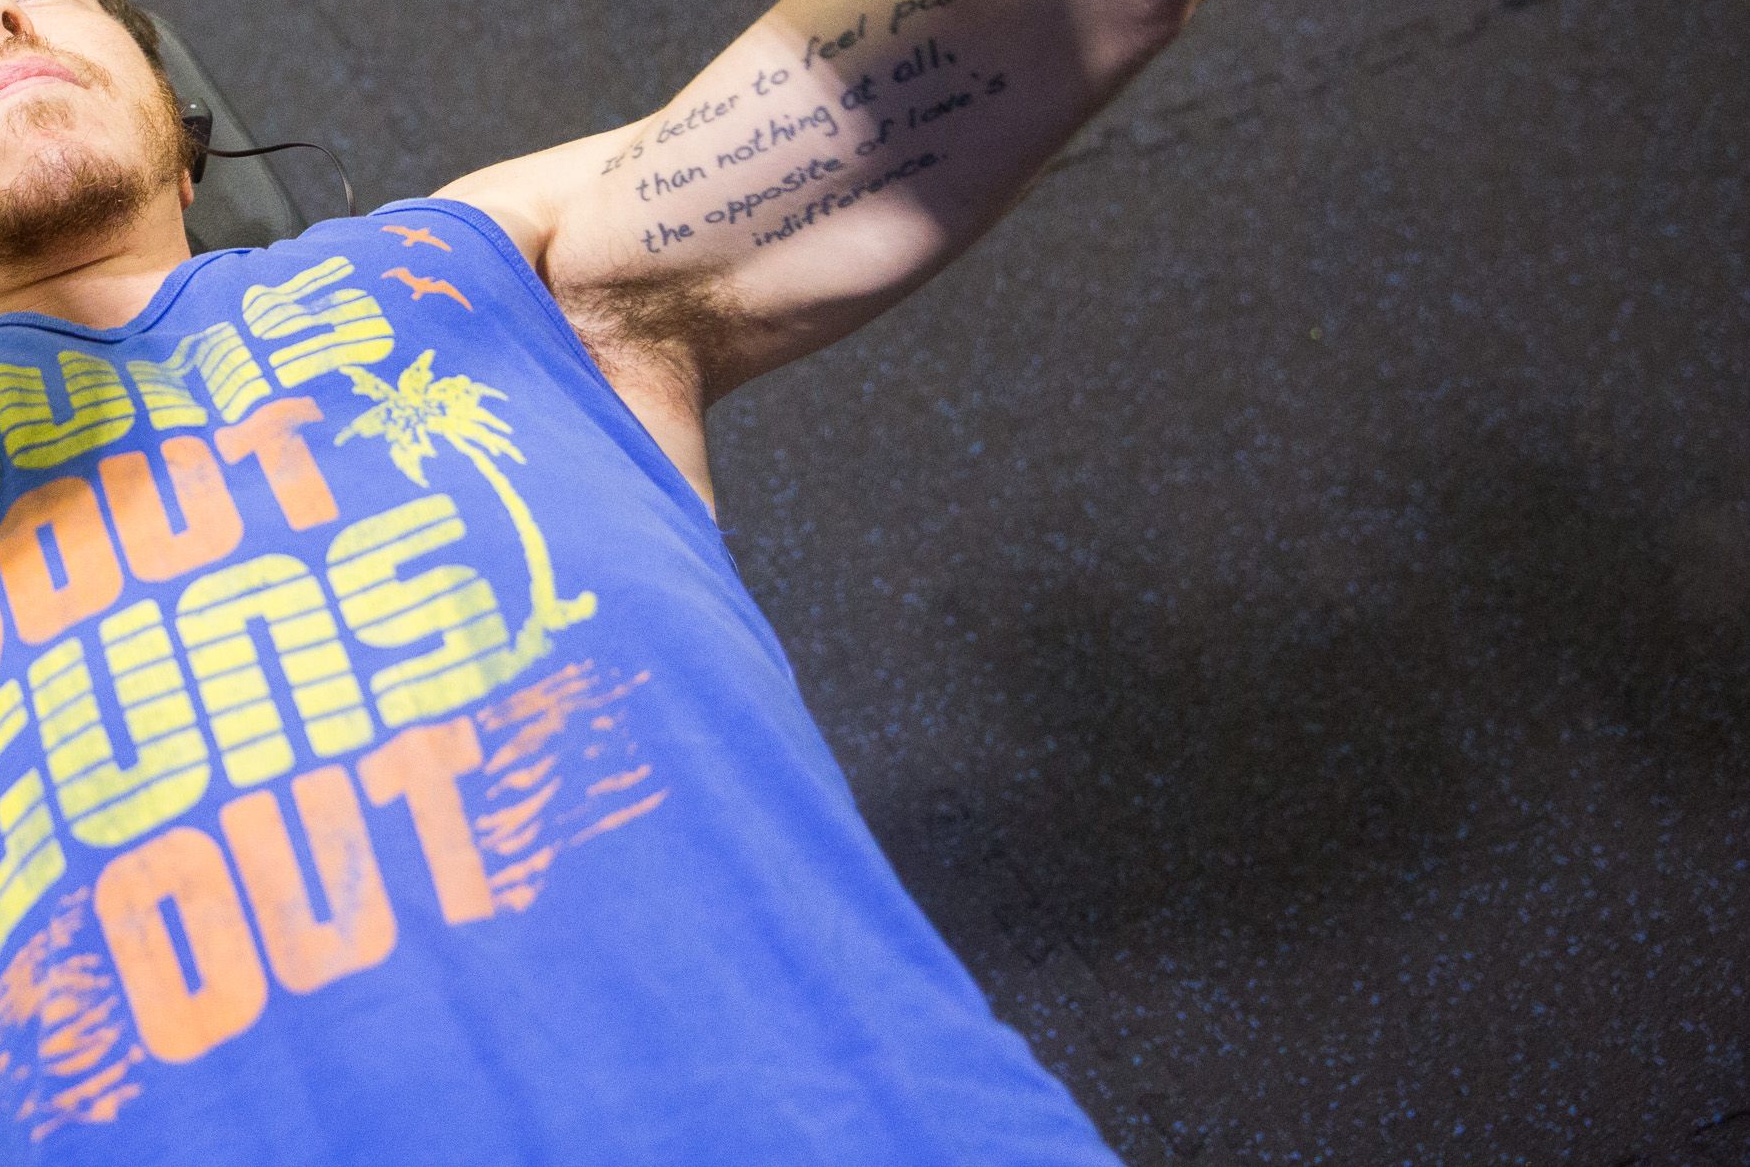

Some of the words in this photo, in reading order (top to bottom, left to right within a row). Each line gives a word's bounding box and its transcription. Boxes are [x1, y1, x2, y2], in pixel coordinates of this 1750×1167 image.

[636, 165, 706, 203] than
[716, 104, 838, 171] nothing
[840, 77, 879, 114] at
[656, 94, 740, 145] better
[751, 68, 790, 98] to
[802, 13, 868, 69] feel
[641, 221, 695, 255] the
[703, 156, 846, 226] opposite
[854, 118, 895, 158] of
[906, 70, 1009, 129] love's
[95, 715, 493, 1063] OUT
